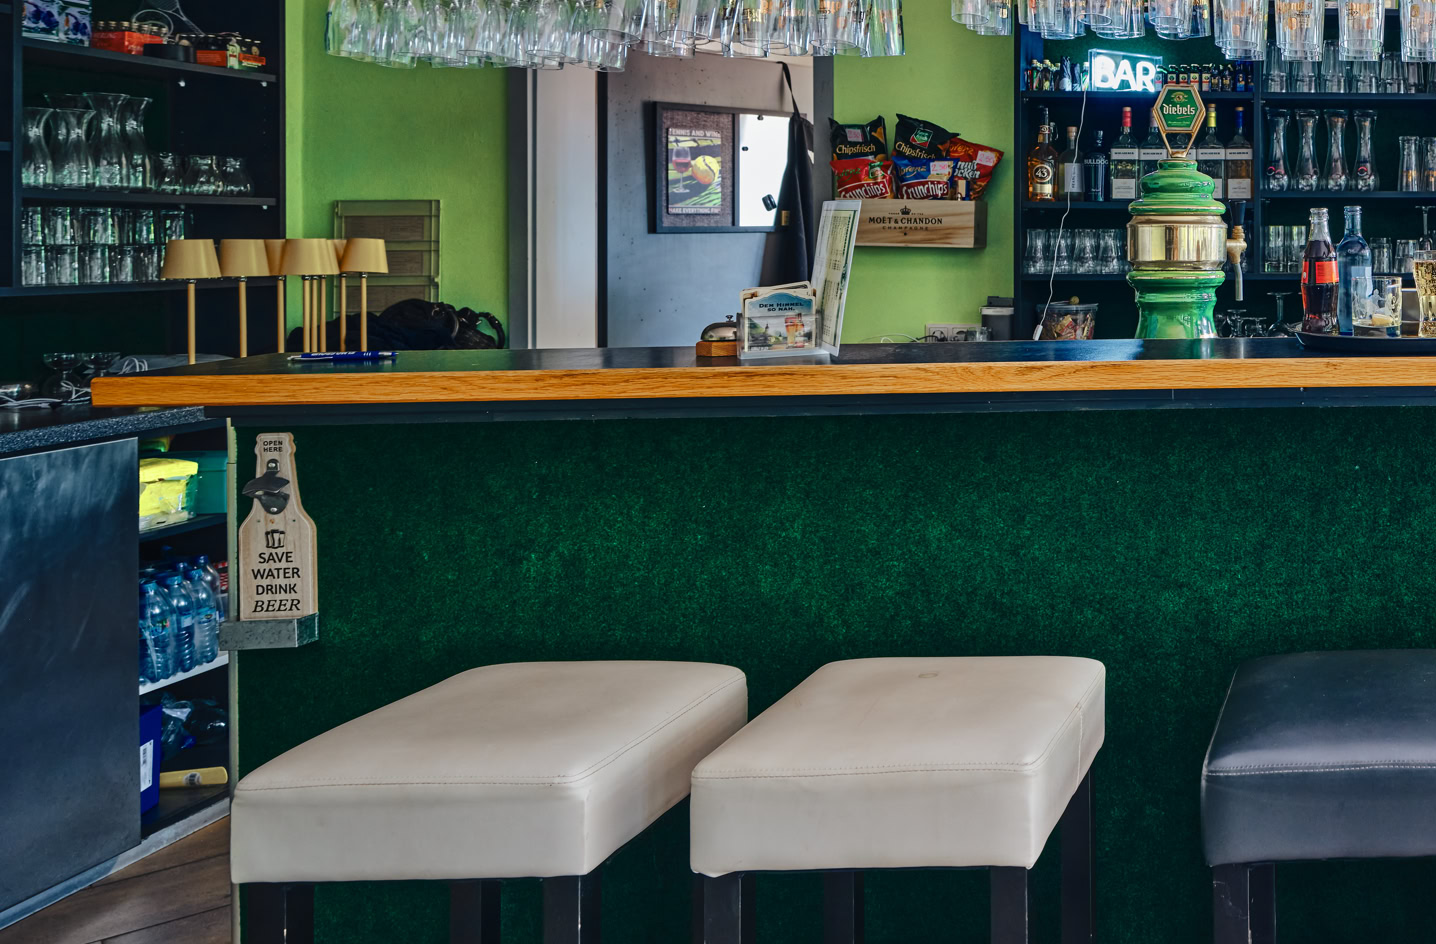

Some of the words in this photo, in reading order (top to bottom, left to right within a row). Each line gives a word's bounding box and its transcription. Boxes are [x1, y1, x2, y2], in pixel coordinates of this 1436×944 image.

[1094, 54, 1156, 93] BAR
[836, 143, 876, 155] Chipsfrisch
[895, 141, 936, 159] Chipsfrisch
[1035, 168, 1048, 178] 43
[902, 181, 948, 199] Crunchips
[868, 215, 893, 224] MOËT
[900, 217, 943, 225] CHANDON
[258, 552, 293, 564] SAVE
[252, 567, 301, 580] WATER
[256, 583, 298, 595] DRINK
[252, 599, 301, 613] BEER
